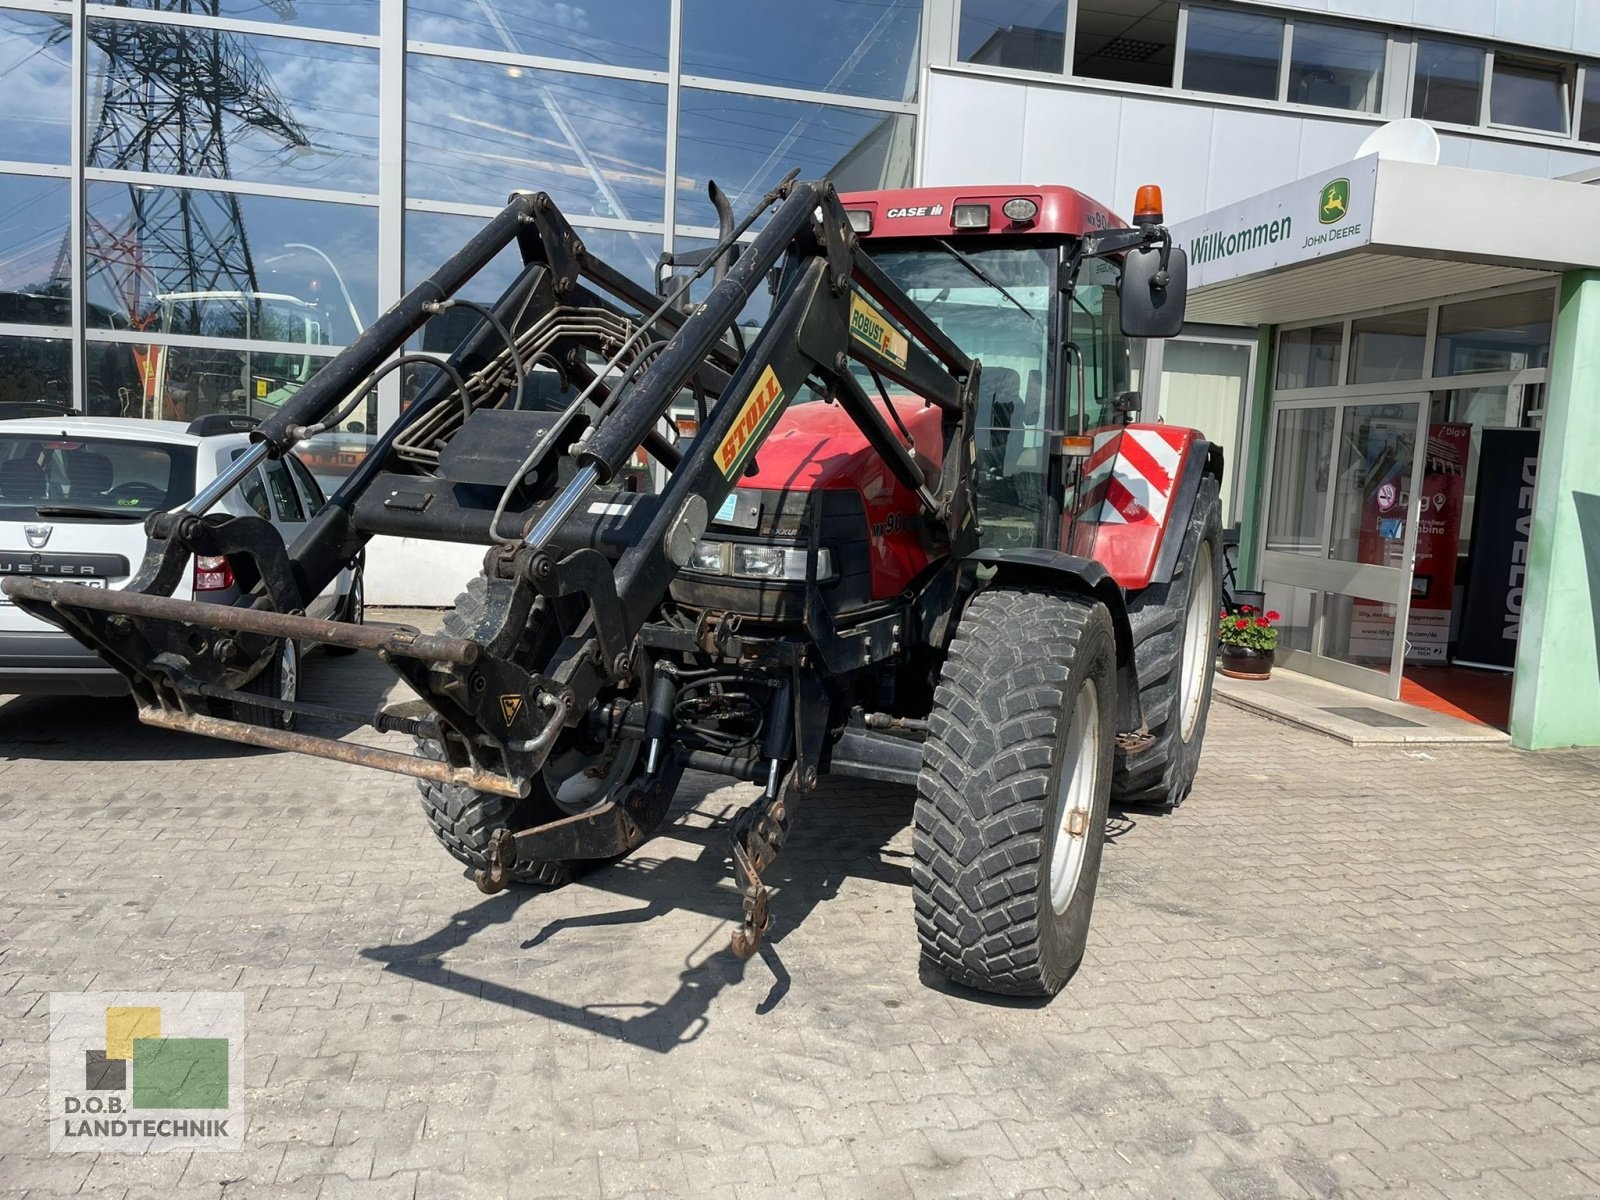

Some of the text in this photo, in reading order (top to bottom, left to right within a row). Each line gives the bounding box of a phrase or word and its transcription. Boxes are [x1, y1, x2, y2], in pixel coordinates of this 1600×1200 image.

[887, 207, 927, 218] CASE
[1190, 215, 1292, 265] Willkommen
[1302, 223, 1362, 249] JOHN DEERE
[851, 308, 885, 343] ROBUST
[721, 376, 779, 470] STOLL
[1417, 525, 1445, 535] abine
[1502, 457, 1538, 640] DEVELON
[0, 563, 95, 574] USTER
